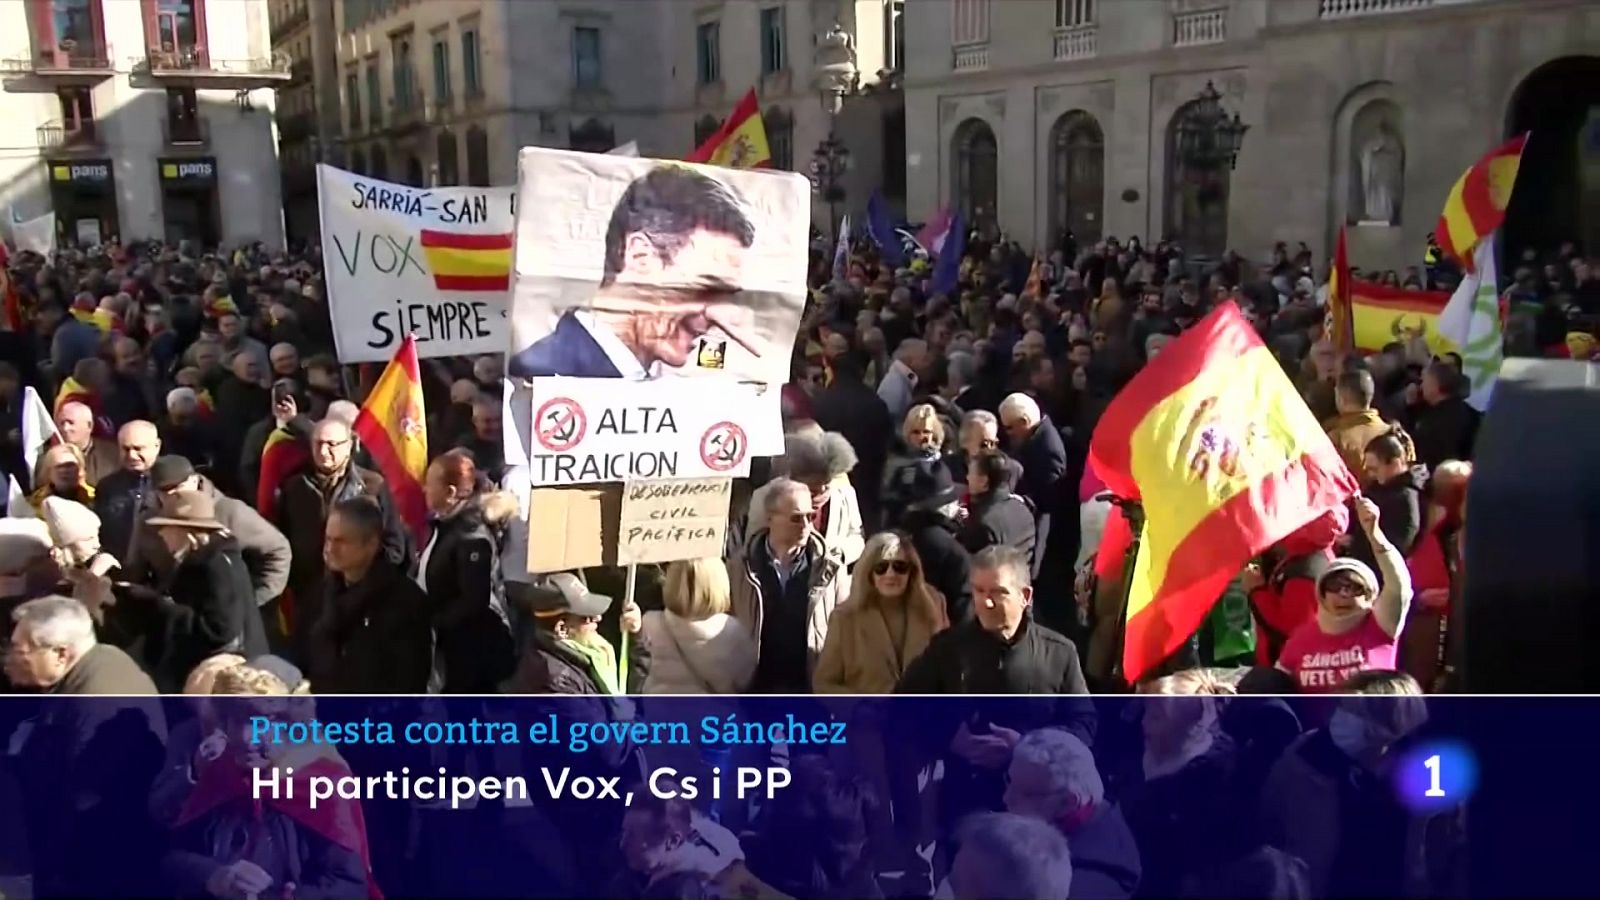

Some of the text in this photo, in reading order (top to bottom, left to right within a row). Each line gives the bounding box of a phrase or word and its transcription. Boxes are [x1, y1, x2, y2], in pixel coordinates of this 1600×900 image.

[72, 165, 107, 178] pans
[179, 163, 212, 176] pans
[333, 229, 425, 277] VOX
[595, 407, 678, 435] ALTA
[534, 450, 678, 481] TRAICION
[649, 506, 698, 519] CIVIL
[1300, 669, 1336, 687] VETE
